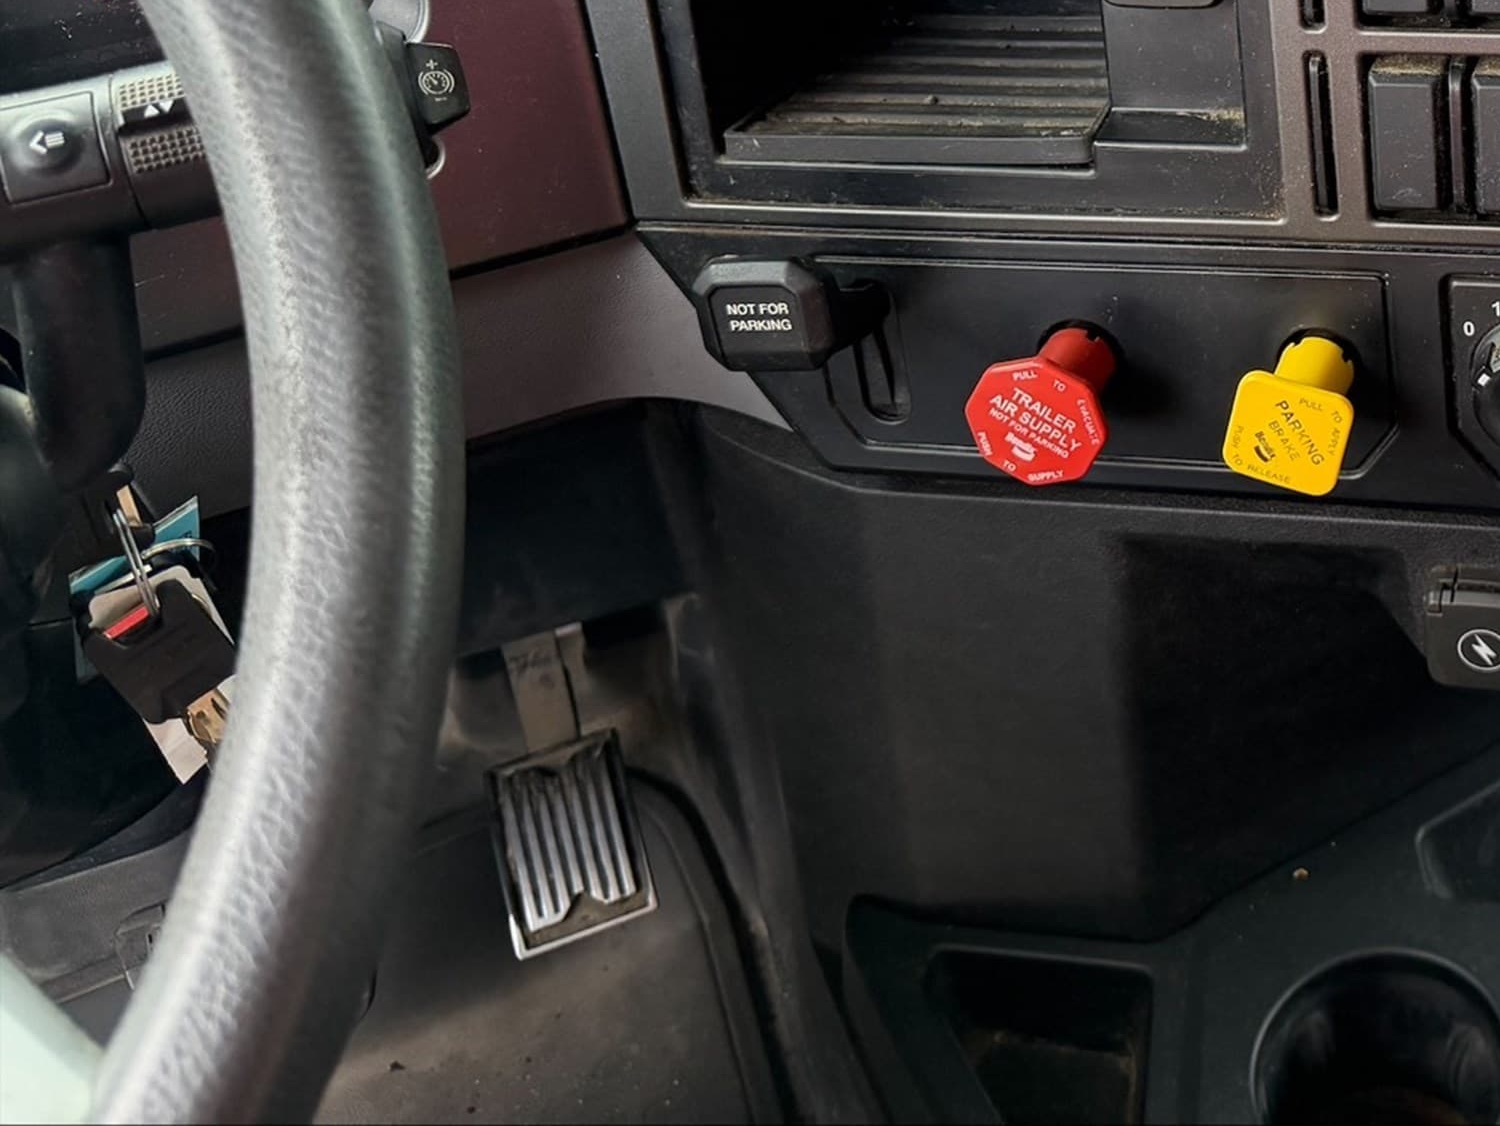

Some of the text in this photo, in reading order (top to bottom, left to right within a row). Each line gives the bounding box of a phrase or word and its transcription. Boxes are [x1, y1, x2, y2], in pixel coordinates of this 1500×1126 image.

[726, 303, 789, 315] NOT FOR
[1492, 302, 1500, 317] 1
[730, 319, 792, 331] PARKING
[1464, 322, 1475, 336] 0
[1012, 370, 1038, 381] PULL
[1053, 380, 1066, 392] TO
[989, 395, 1082, 452] AIR SUPPLY
[1012, 387, 1076, 434] TRAILER
[1331, 410, 1343, 424] TO
[989, 408, 1069, 459] NOT FOR PARKING
[1268, 421, 1300, 461] BRAKE
[1276, 400, 1324, 465] PARKING
[977, 432, 1064, 481] PUSH TO SUPPLY
[1233, 454, 1243, 466] TO
[1247, 464, 1291, 484] RELEASE
